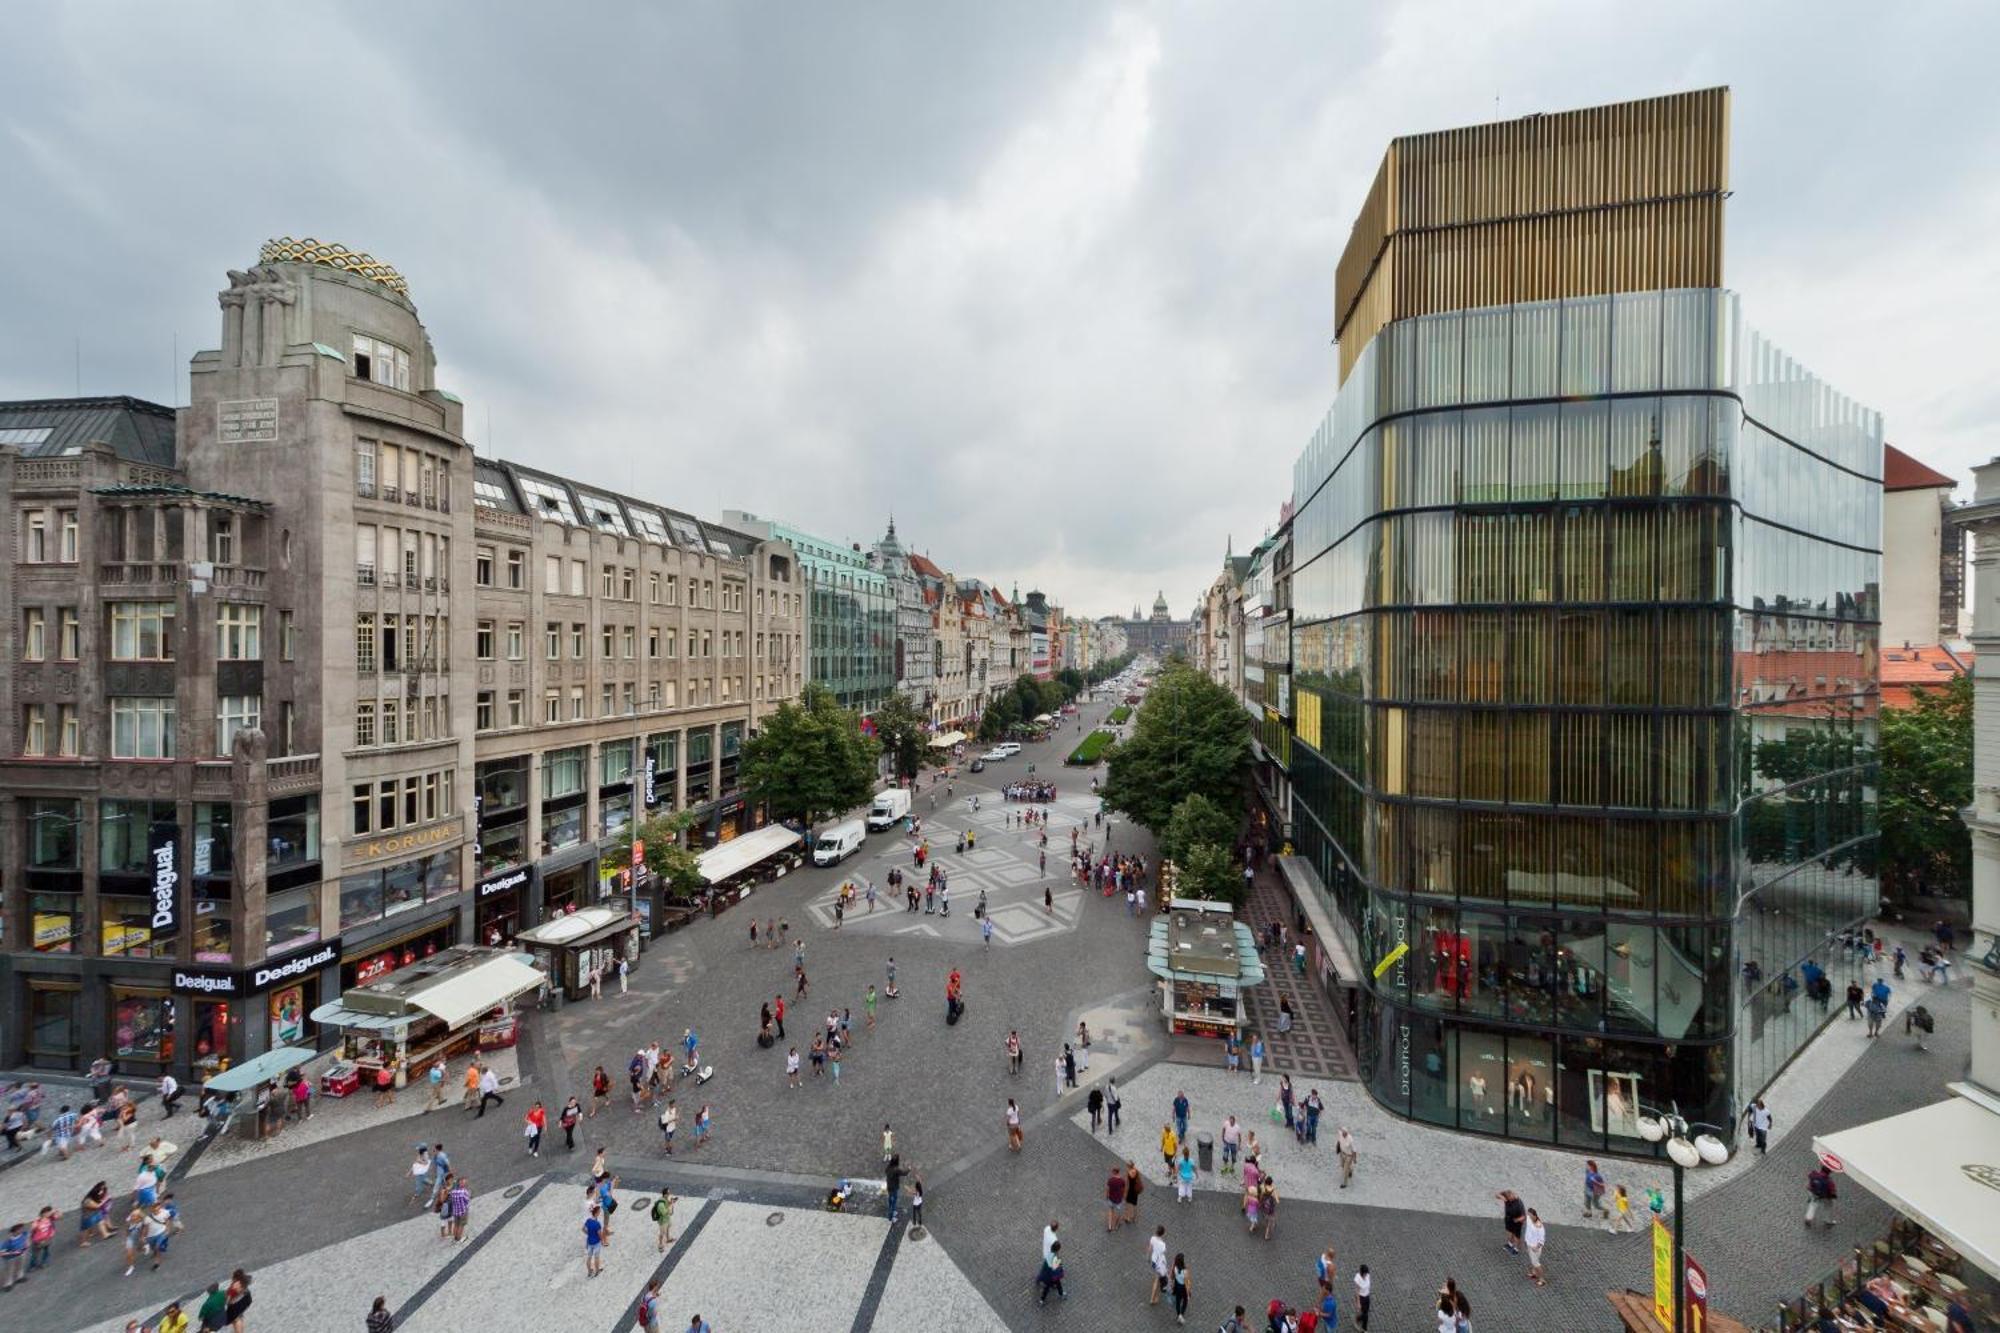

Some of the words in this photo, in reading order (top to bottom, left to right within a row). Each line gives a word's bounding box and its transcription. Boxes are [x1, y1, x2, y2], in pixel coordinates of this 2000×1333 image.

[368, 826, 451, 857] KORUNA
[152, 840, 179, 929] Desigual.
[255, 946, 337, 986] Desigual.
[1396, 917, 1405, 987] prood
[175, 972, 236, 992] Desigual.
[1400, 1026, 1410, 1097] promod
